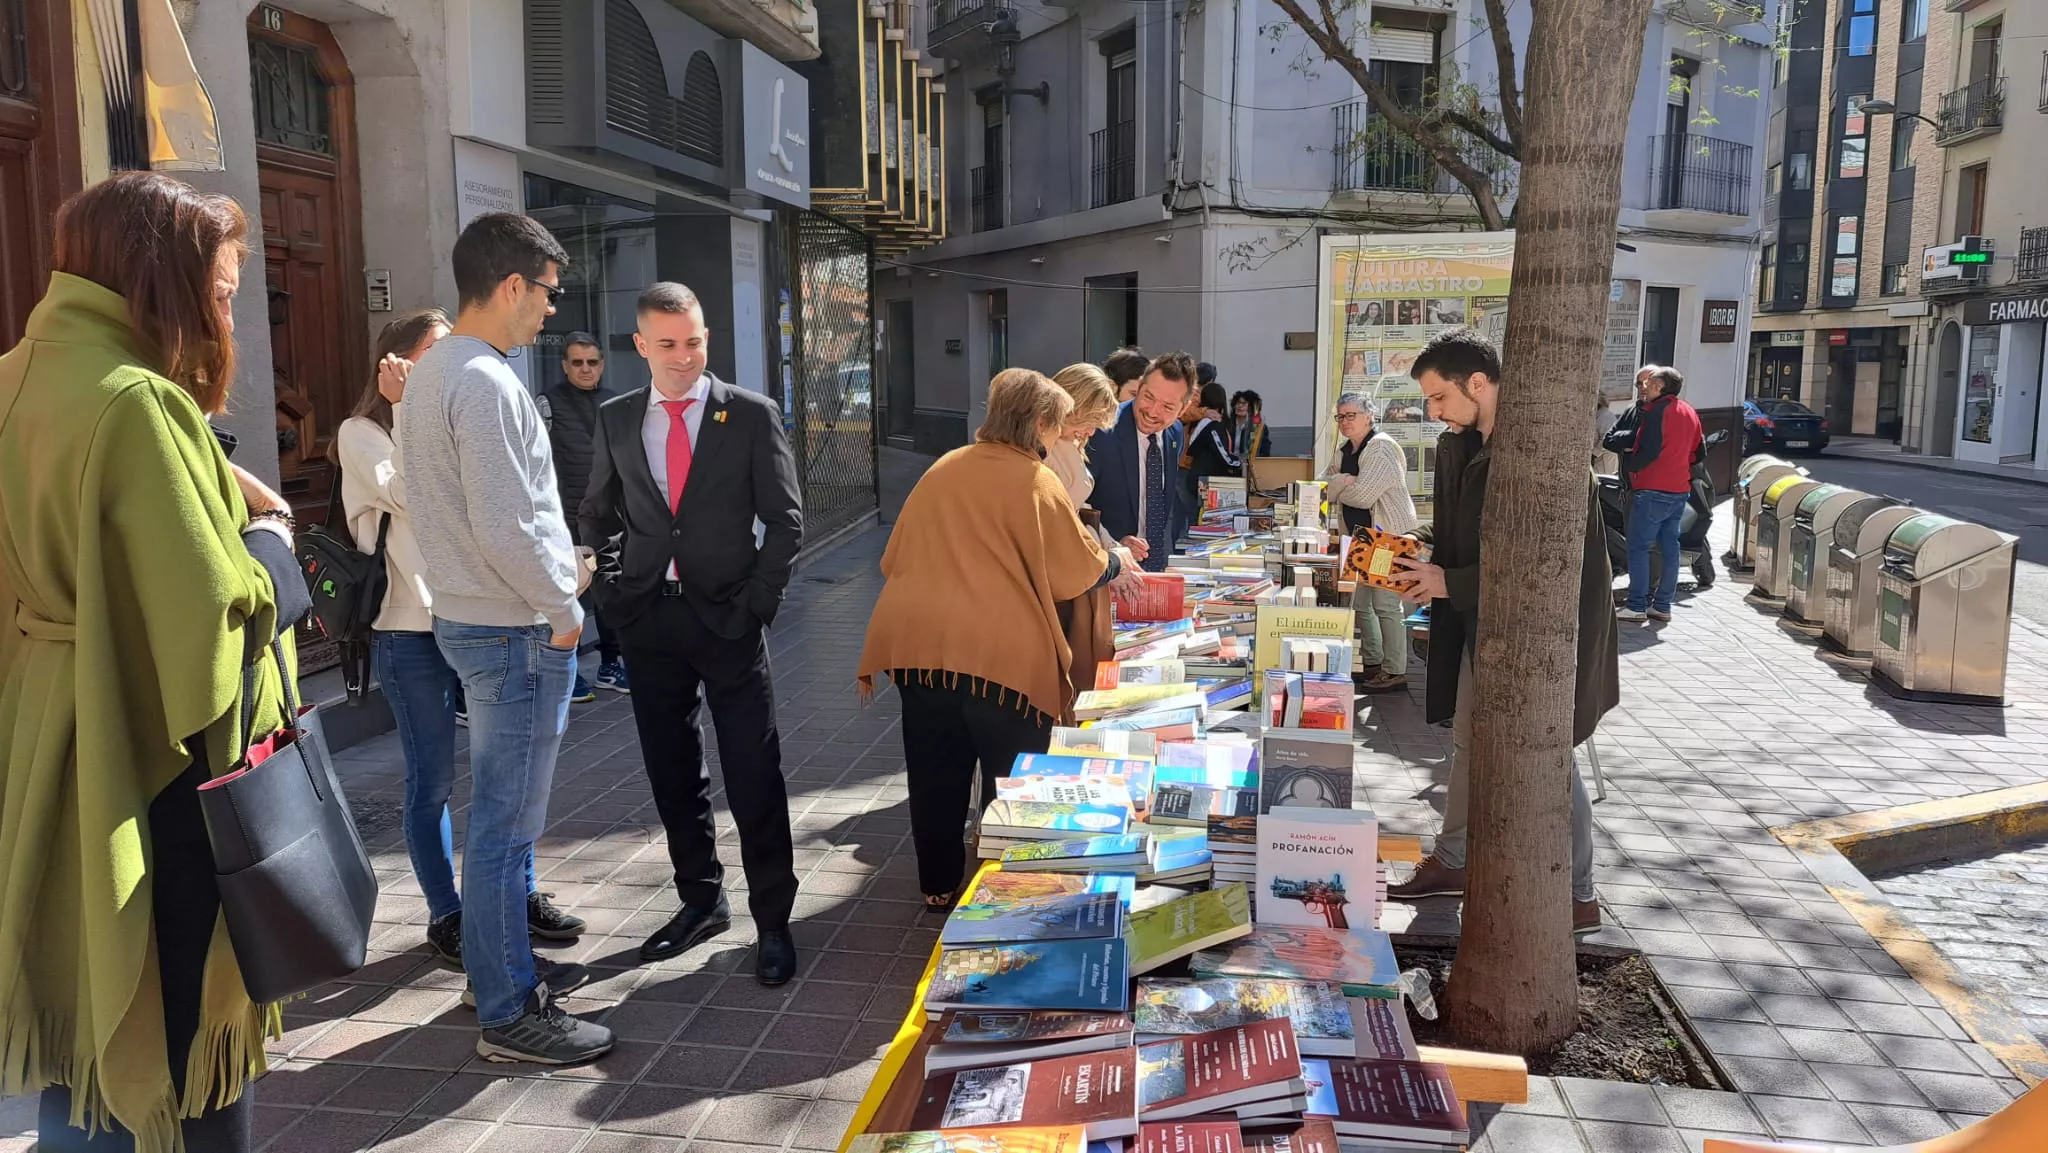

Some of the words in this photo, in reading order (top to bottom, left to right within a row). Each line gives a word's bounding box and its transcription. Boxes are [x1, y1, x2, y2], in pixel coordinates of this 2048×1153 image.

[264, 7, 281, 31] 16
[464, 180, 513, 199] ASESORAMIENTO
[465, 193, 514, 213] PERSONALIZADO
[1346, 258, 1448, 277] CULTURA
[1344, 275, 1484, 293] BARBASTRO
[1276, 617, 1291, 628] El
[1292, 617, 1339, 630] infinito
[1290, 833, 1317, 841] RAMÓN
[1272, 841, 1354, 856] PROFANACIÓN
[1075, 1064, 1092, 1104] ESCARTÍN
[1174, 1125, 1183, 1134] LA
[1175, 1136, 1185, 1152] ALTA
